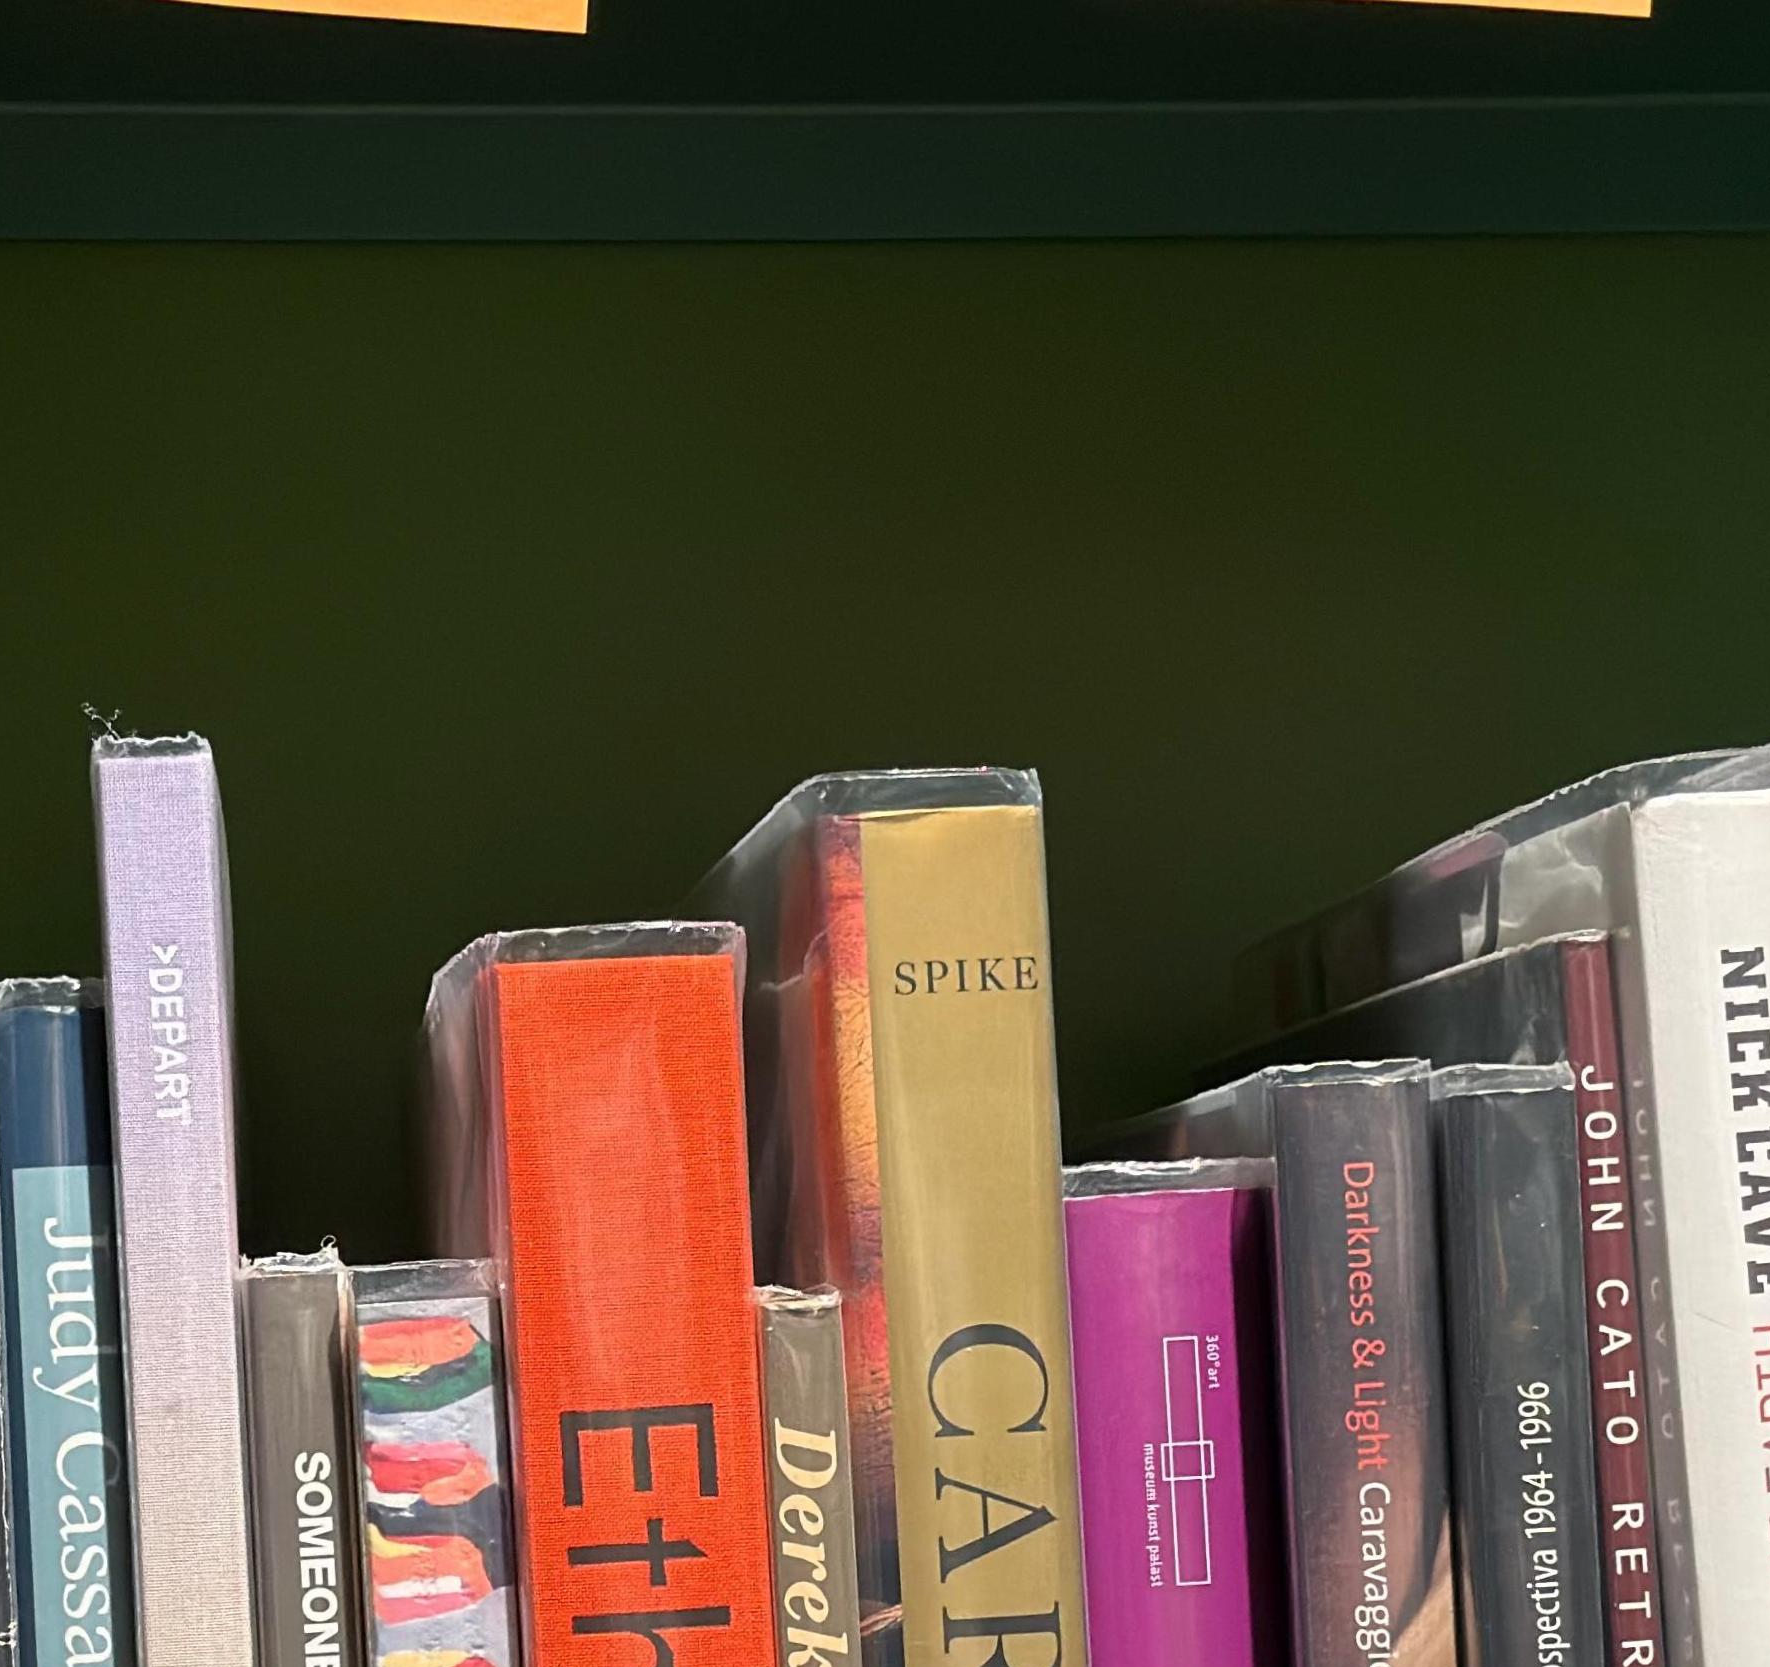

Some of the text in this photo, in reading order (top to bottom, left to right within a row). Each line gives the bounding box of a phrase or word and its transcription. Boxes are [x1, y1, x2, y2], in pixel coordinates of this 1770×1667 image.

[893, 955, 1040, 998] SPIKE
[1581, 1066, 1624, 1231] JOHN
[33, 1217, 112, 1412] Judy
[1343, 1161, 1380, 1328] Darkness
[1345, 1382, 1391, 1470] Light
[1353, 1338, 1386, 1369] &
[1596, 1279, 1638, 1445] CATO
[1143, 1443, 1164, 1588] museum kunst palast
